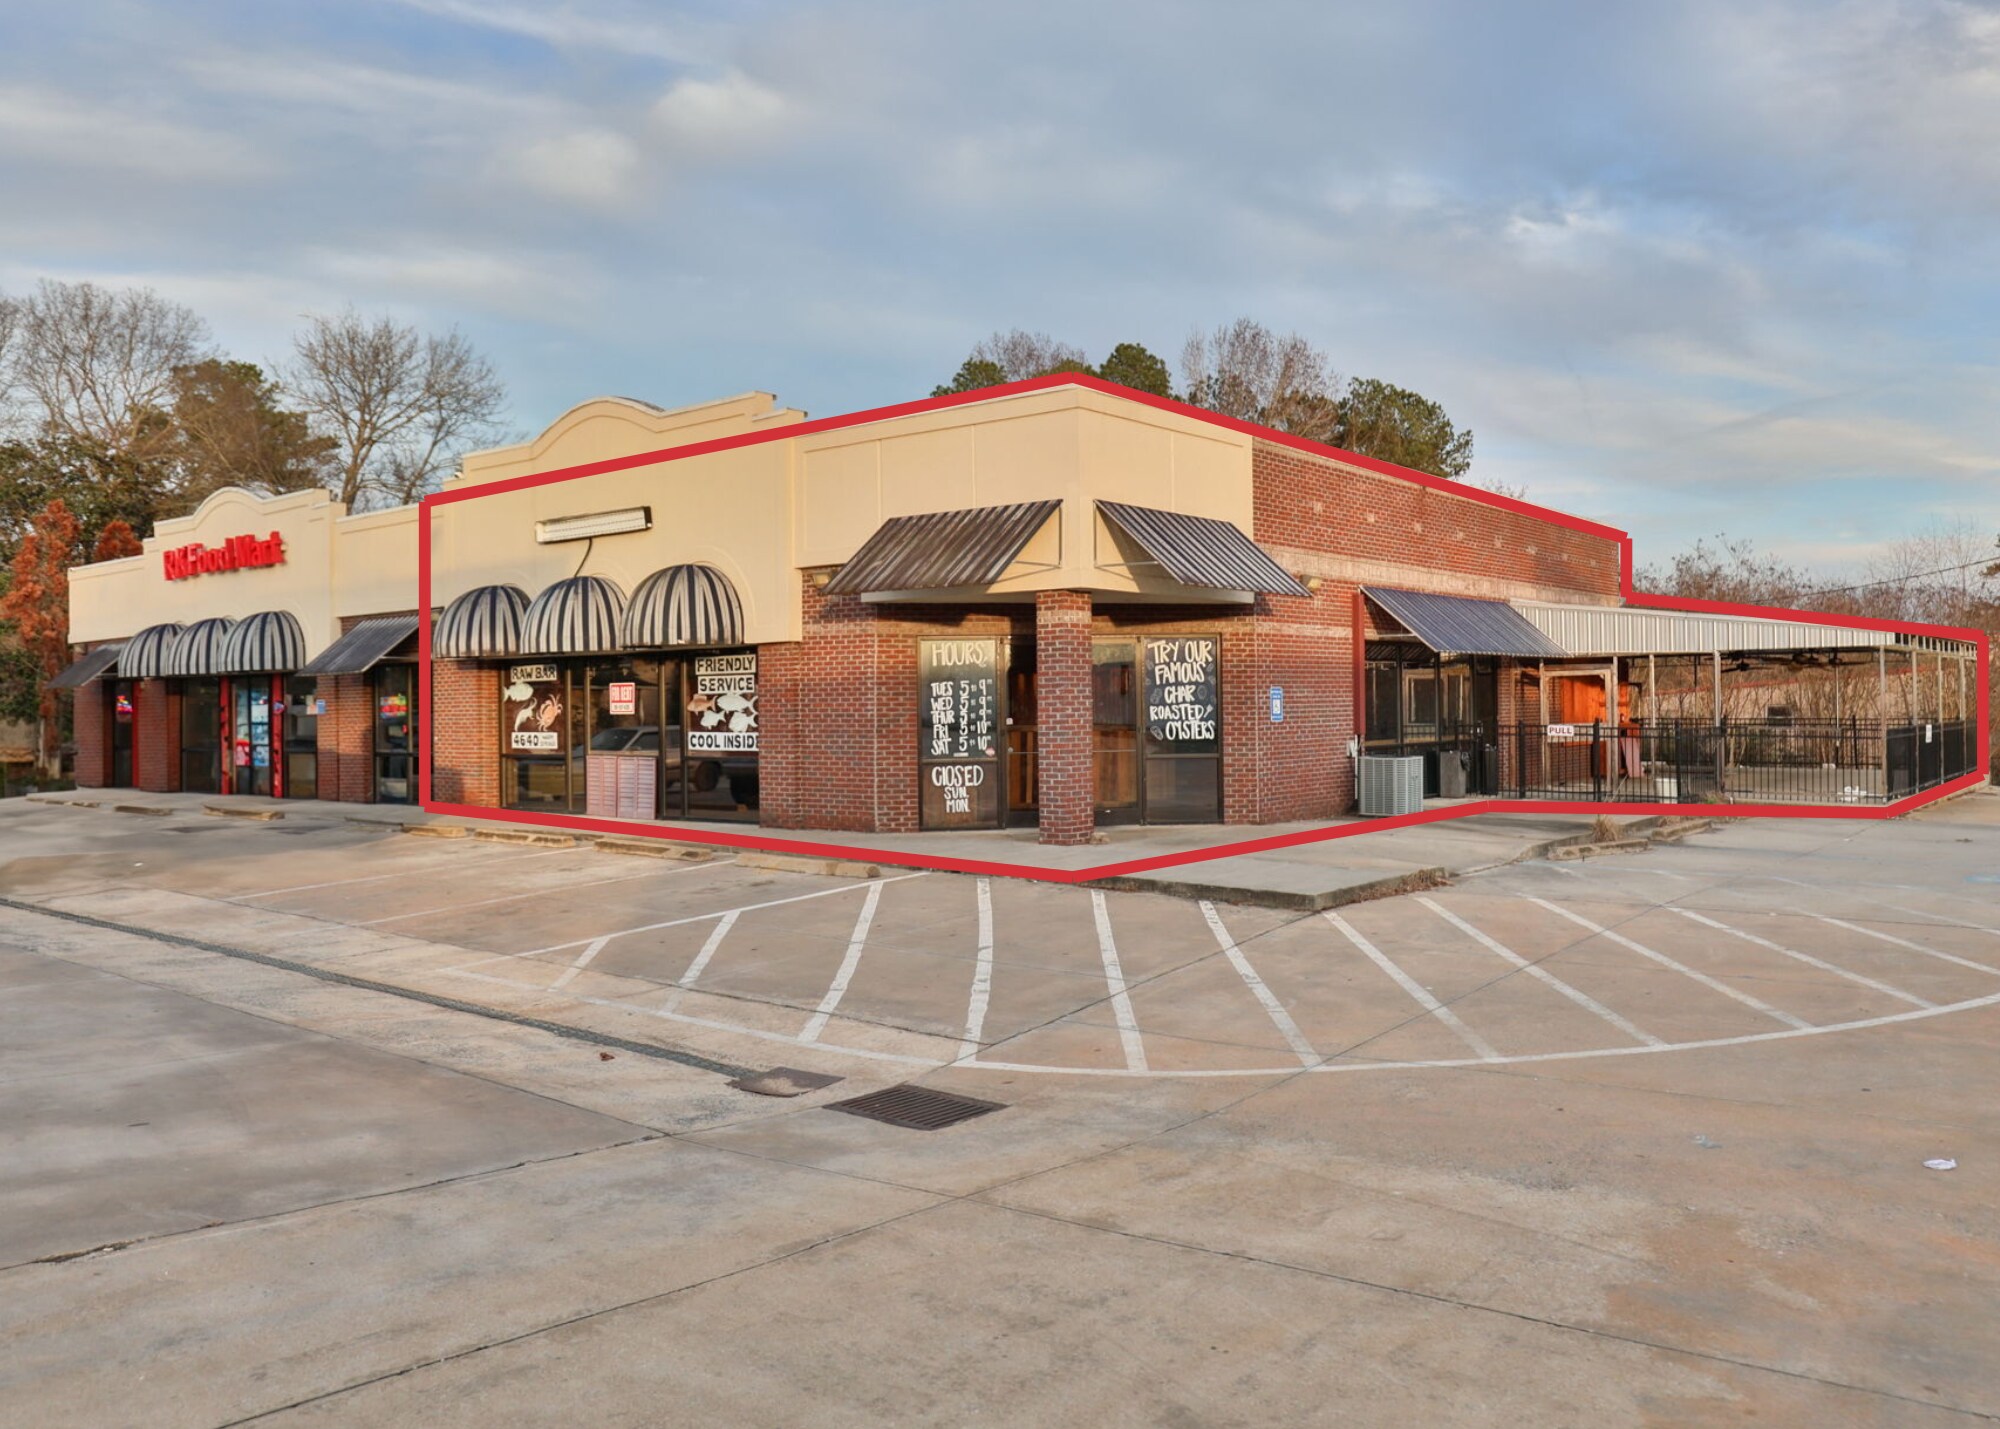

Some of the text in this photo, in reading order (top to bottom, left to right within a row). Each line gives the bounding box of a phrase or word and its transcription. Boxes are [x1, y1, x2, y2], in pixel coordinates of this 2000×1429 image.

[187, 538, 235, 575] Food
[235, 531, 284, 568] Mart
[931, 642, 983, 667] HOURS
[1148, 640, 1213, 664] TRY OUR
[697, 656, 754, 672] FRIENDLY
[512, 666, 556, 680] RAW BAR
[1155, 662, 1206, 685] FAMOUS
[700, 677, 753, 691] SERVICE
[931, 681, 954, 697] TUES
[959, 680, 970, 696] 5
[1164, 685, 1196, 704] CHAR
[931, 696, 953, 711] WED
[959, 696, 970, 711] 5
[1149, 703, 1205, 721] ROASTED
[930, 710, 955, 725] THUR
[959, 710, 968, 725] 5
[933, 724, 949, 739] FRI
[959, 724, 969, 736] 5
[1165, 720, 1215, 740] OYSTERS
[514, 734, 538, 746] 4640
[690, 735, 720, 748] COOL
[931, 738, 951, 755] SAT
[959, 736, 968, 751] 5
